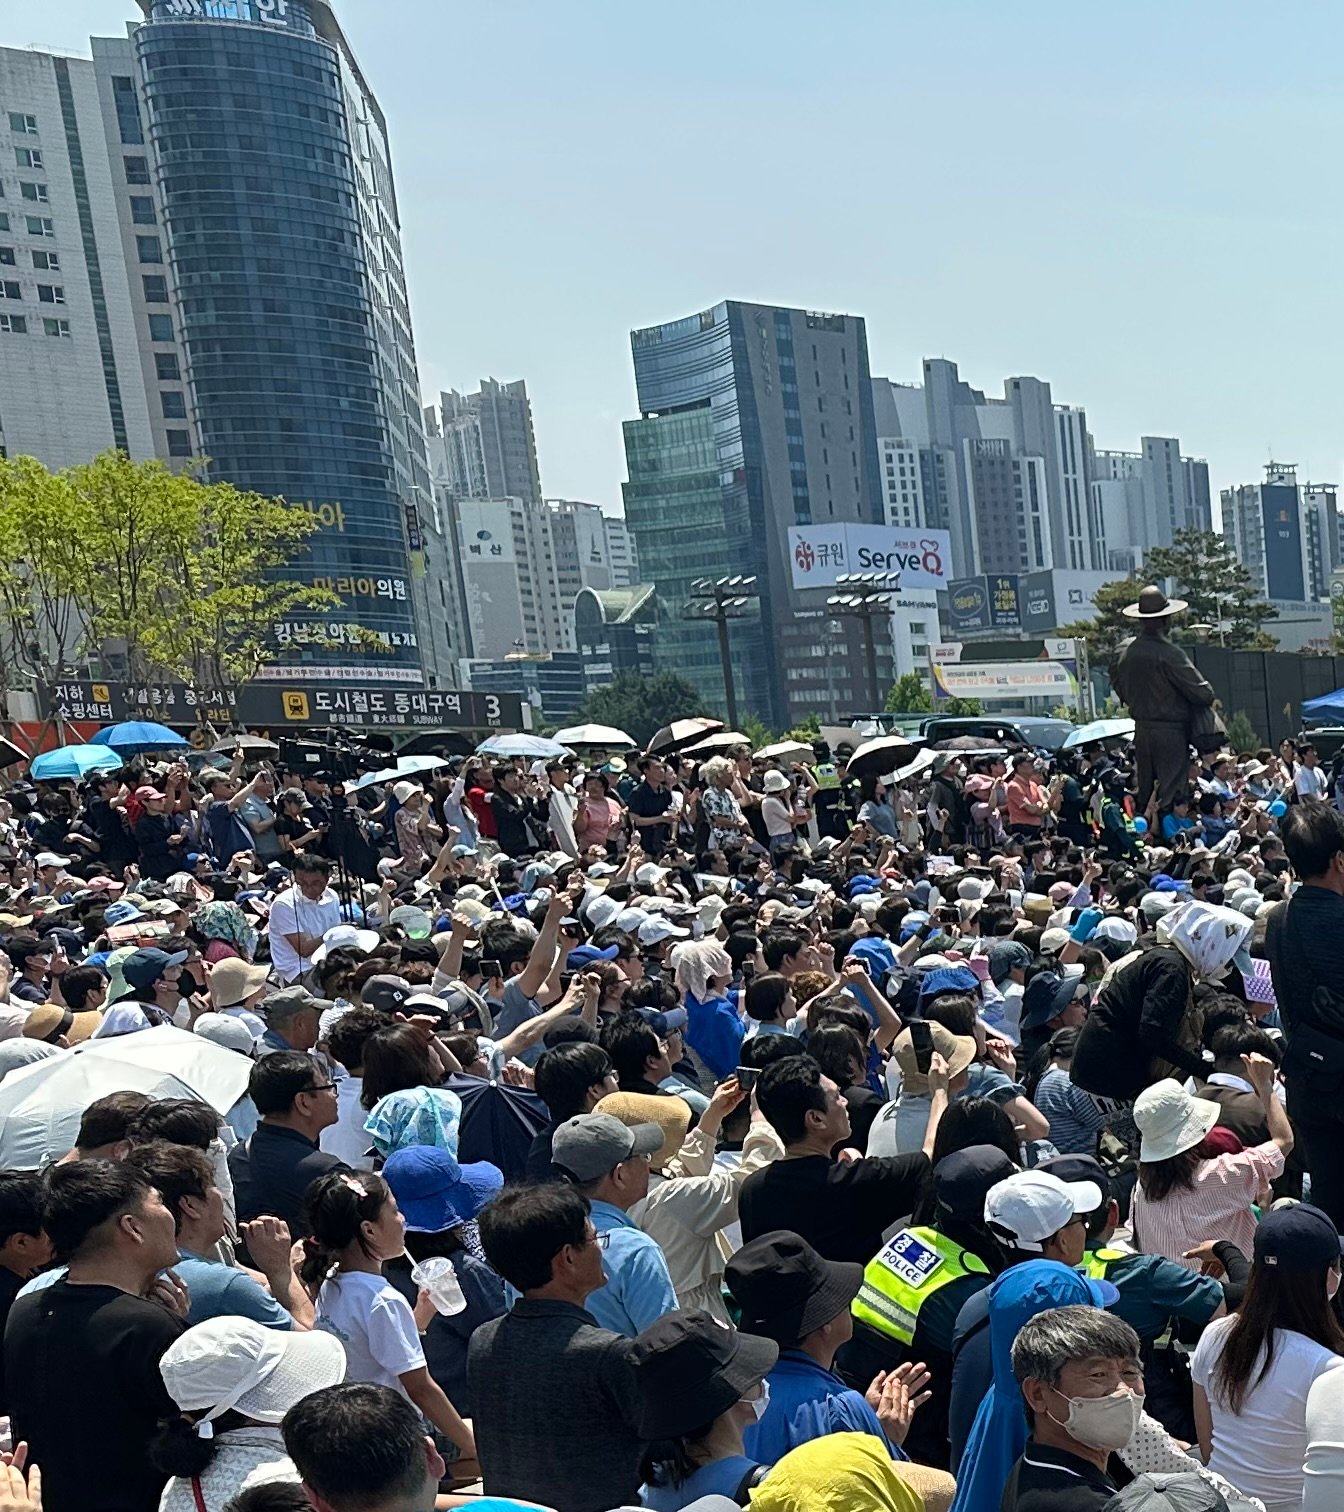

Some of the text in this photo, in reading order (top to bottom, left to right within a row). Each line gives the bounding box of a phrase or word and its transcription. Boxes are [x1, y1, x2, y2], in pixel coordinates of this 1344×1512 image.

[816, 542, 844, 567] 큐원
[55, 685, 83, 701] 지하
[315, 691, 462, 714] 도시철도 동대구역
[485, 695, 500, 719] 3
[413, 715, 444, 725] SUBWAY
[894, 1234, 938, 1272] 경찰
[882, 1250, 921, 1283] POLICE
